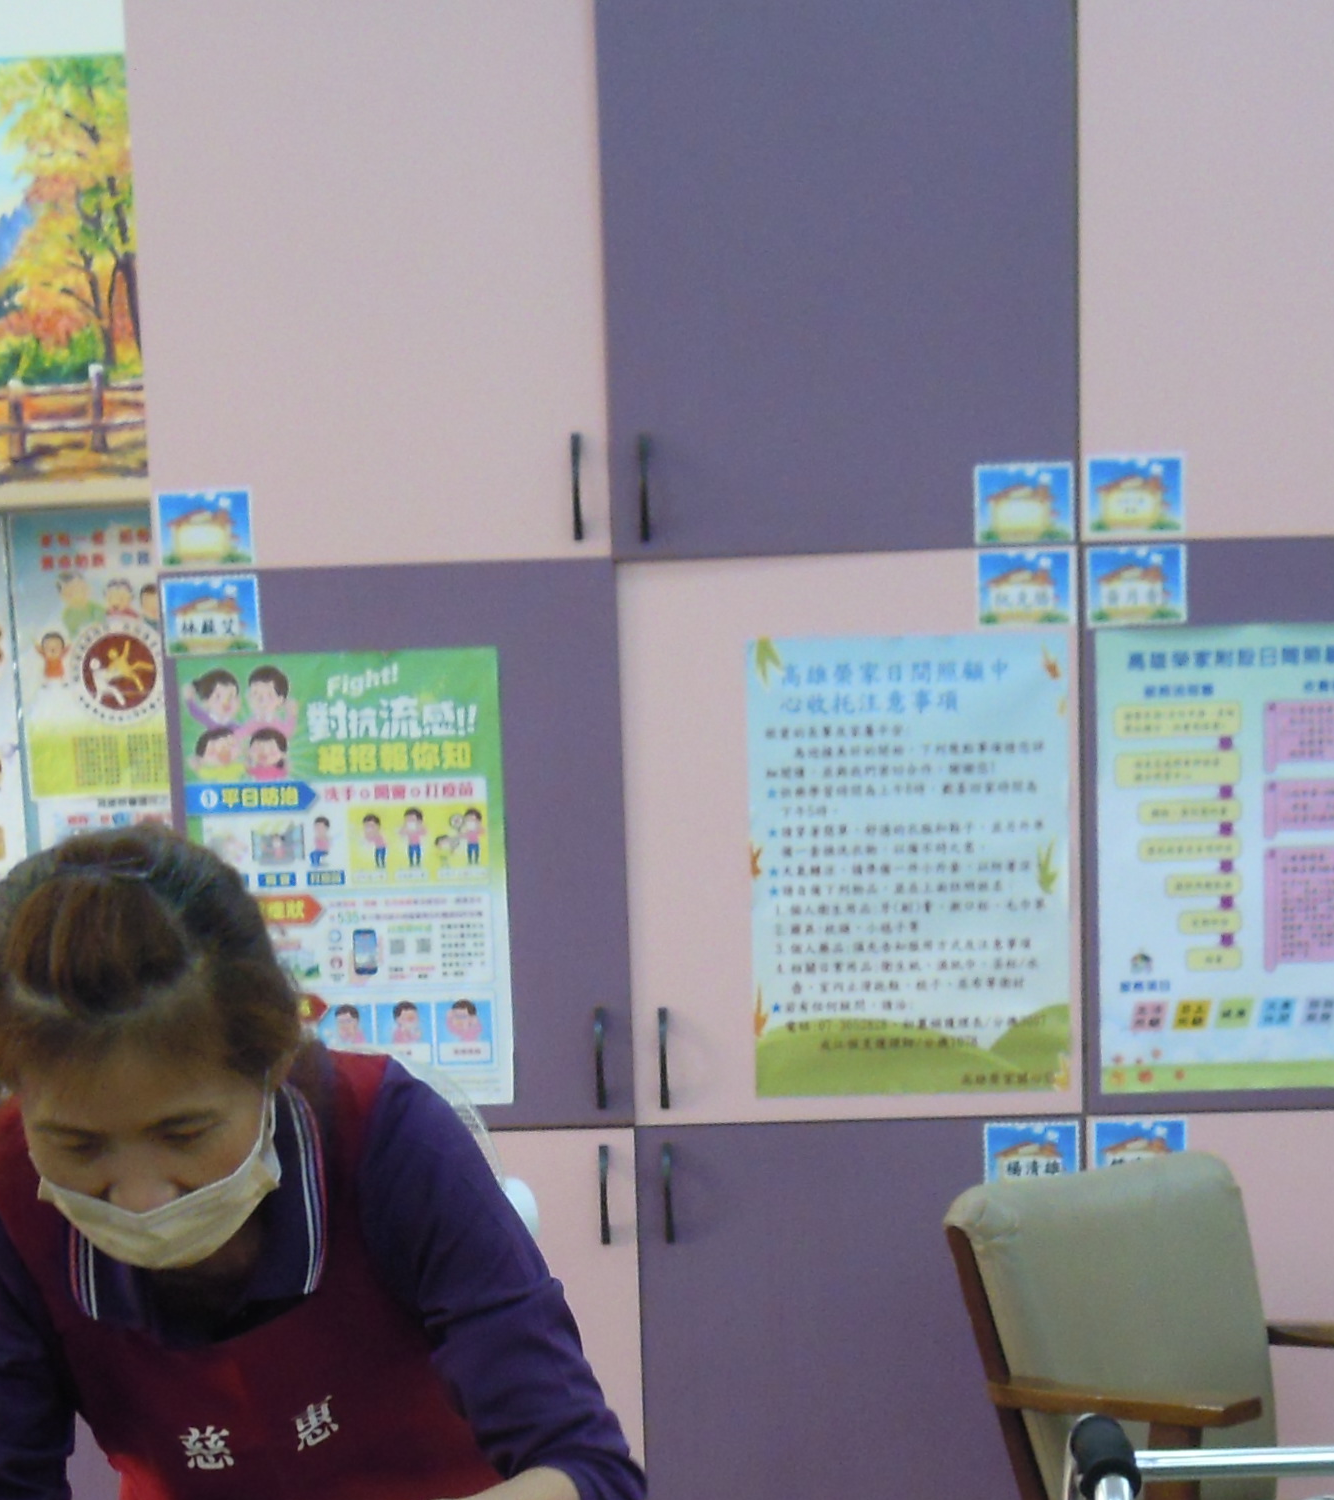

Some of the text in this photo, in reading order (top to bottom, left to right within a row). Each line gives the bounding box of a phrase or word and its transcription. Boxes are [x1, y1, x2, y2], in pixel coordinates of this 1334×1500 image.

[327, 661, 400, 700] Fight!
[782, 659, 1009, 687] 高雄榮家日間照顧中
[780, 689, 959, 715] 心收托注意事項
